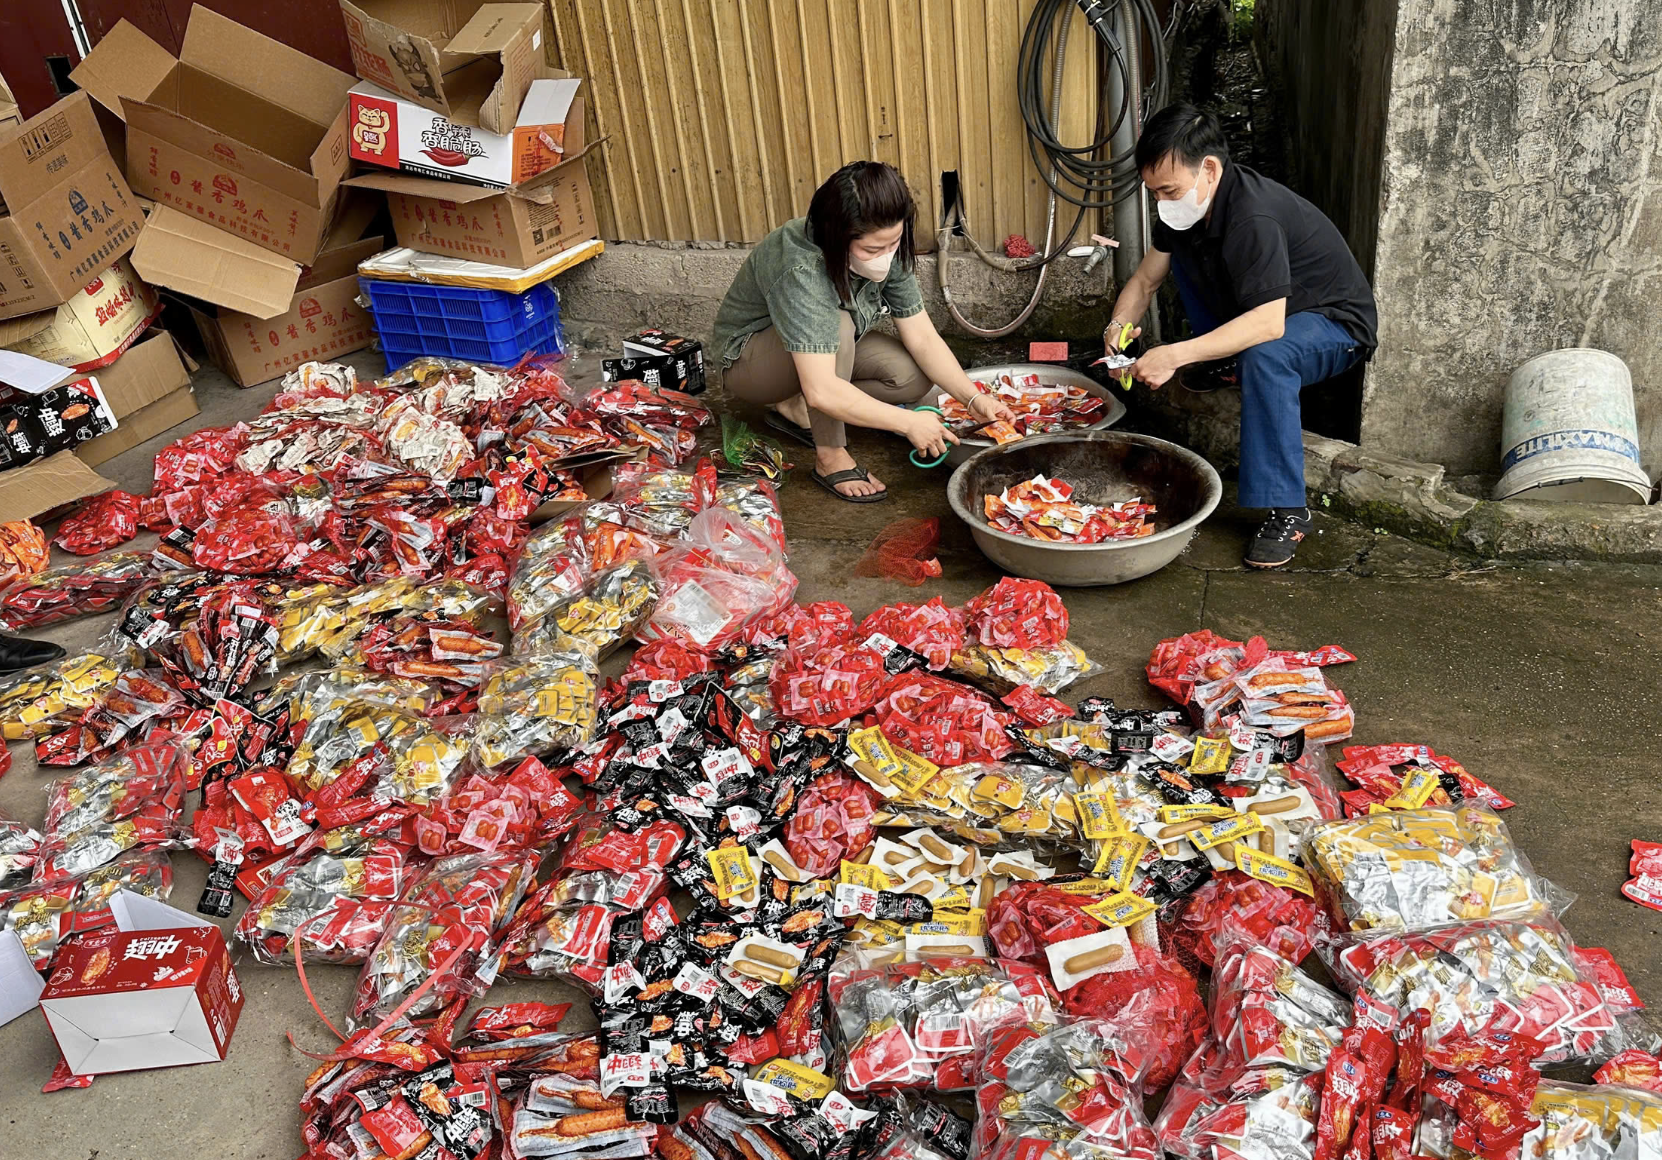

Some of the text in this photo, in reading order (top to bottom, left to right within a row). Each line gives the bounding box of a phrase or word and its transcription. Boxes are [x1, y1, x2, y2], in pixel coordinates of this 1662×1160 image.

[432, 116, 472, 140] 香辣
[420, 130, 484, 156] 香脆肠
[190, 179, 270, 224] 酱香鸡爪
[286, 306, 357, 341] 酱香鸡爪
[121, 934, 184, 961] 翅中
